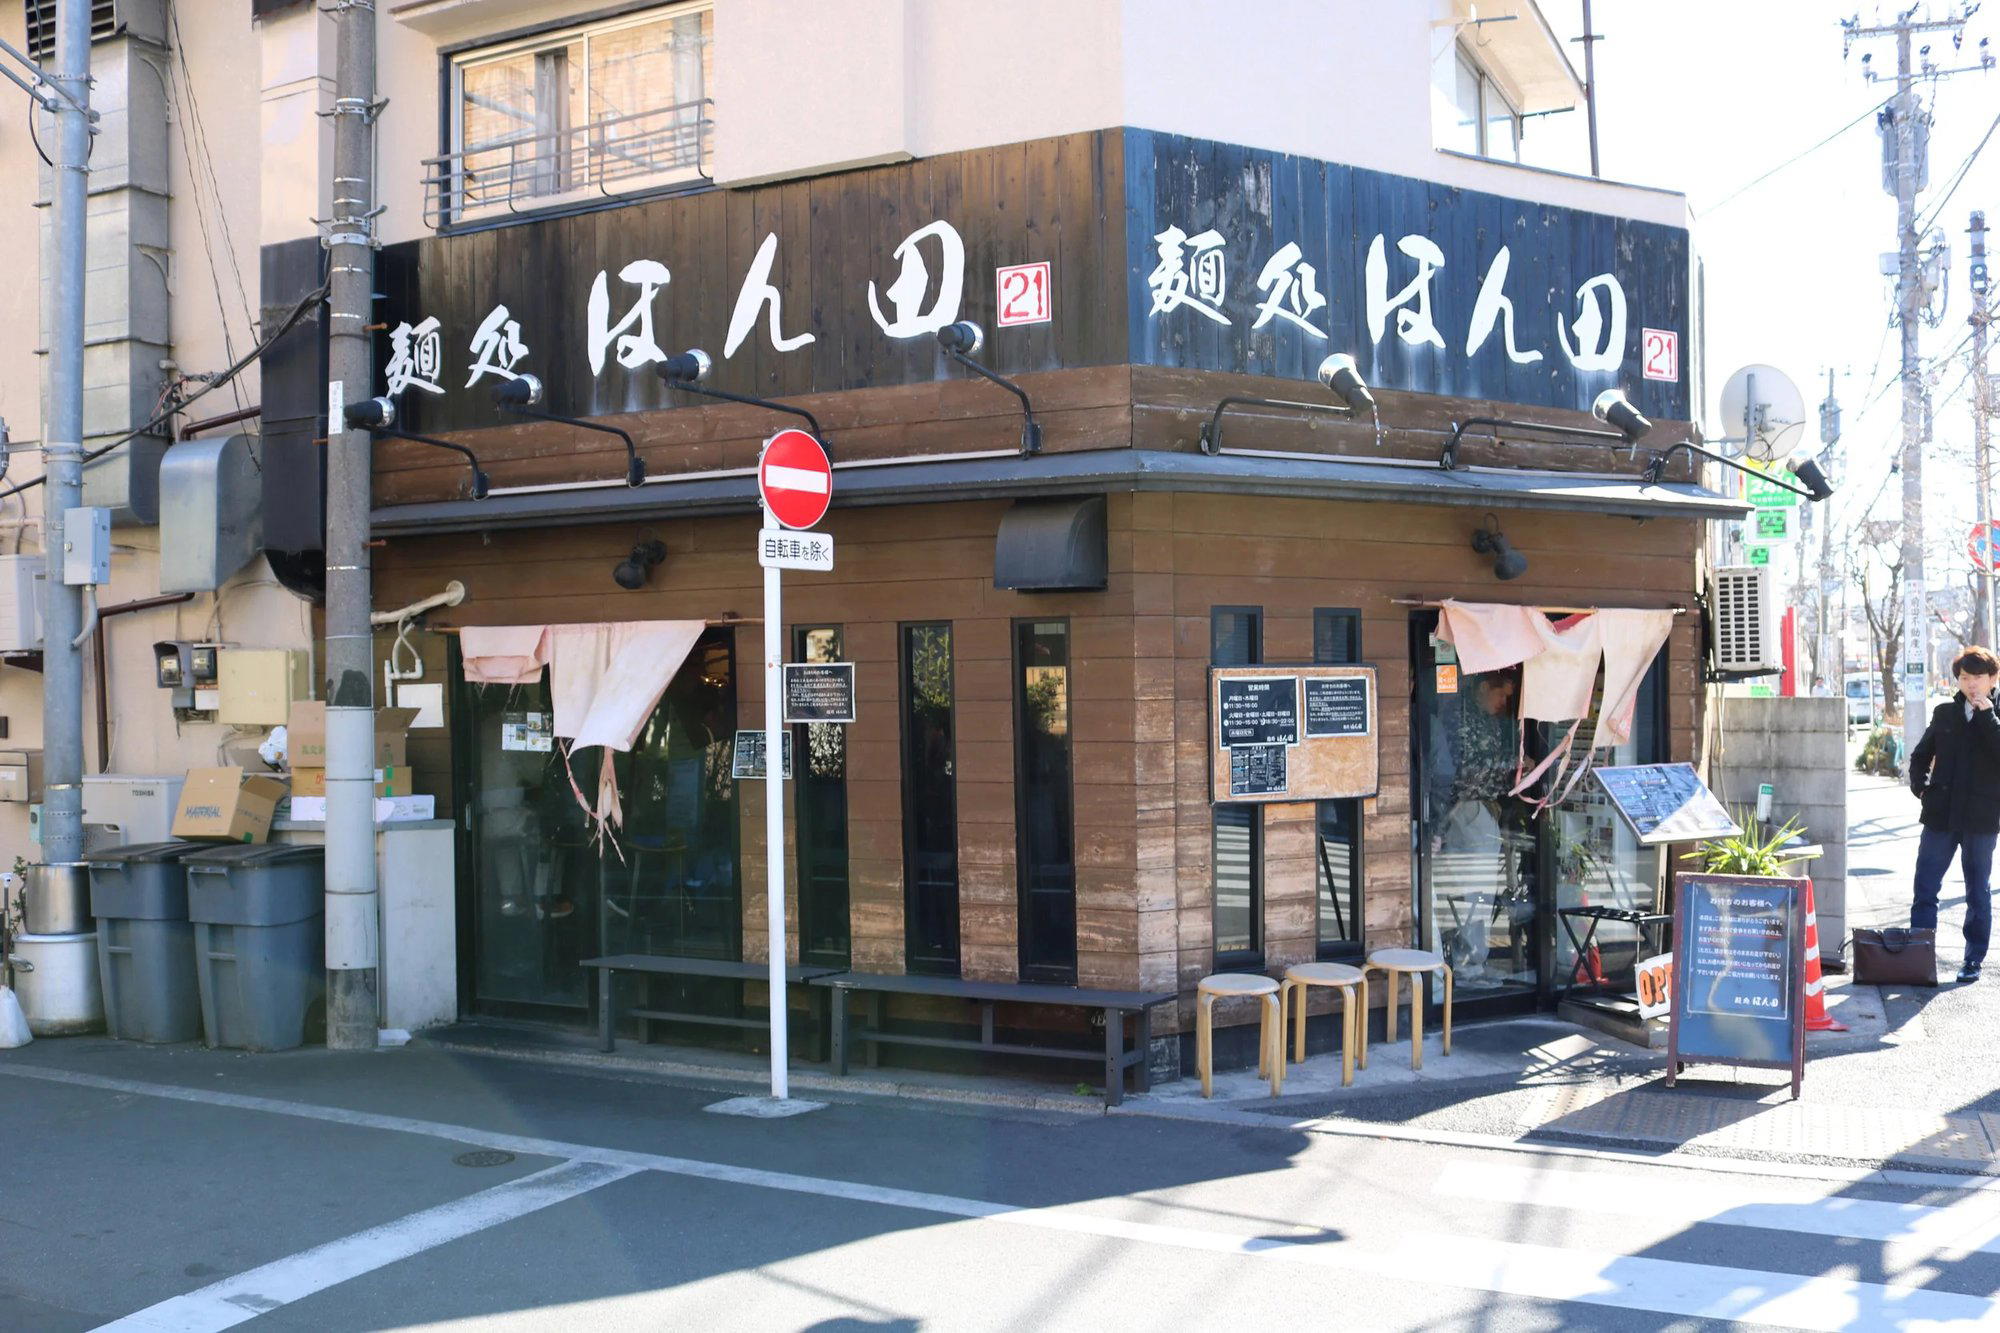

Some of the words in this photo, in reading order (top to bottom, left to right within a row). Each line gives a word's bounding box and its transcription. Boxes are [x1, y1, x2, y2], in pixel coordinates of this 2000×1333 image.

[1003, 269, 1044, 319] 21
[1647, 335, 1674, 376] 21
[765, 537, 829, 561] 自転車を除く
